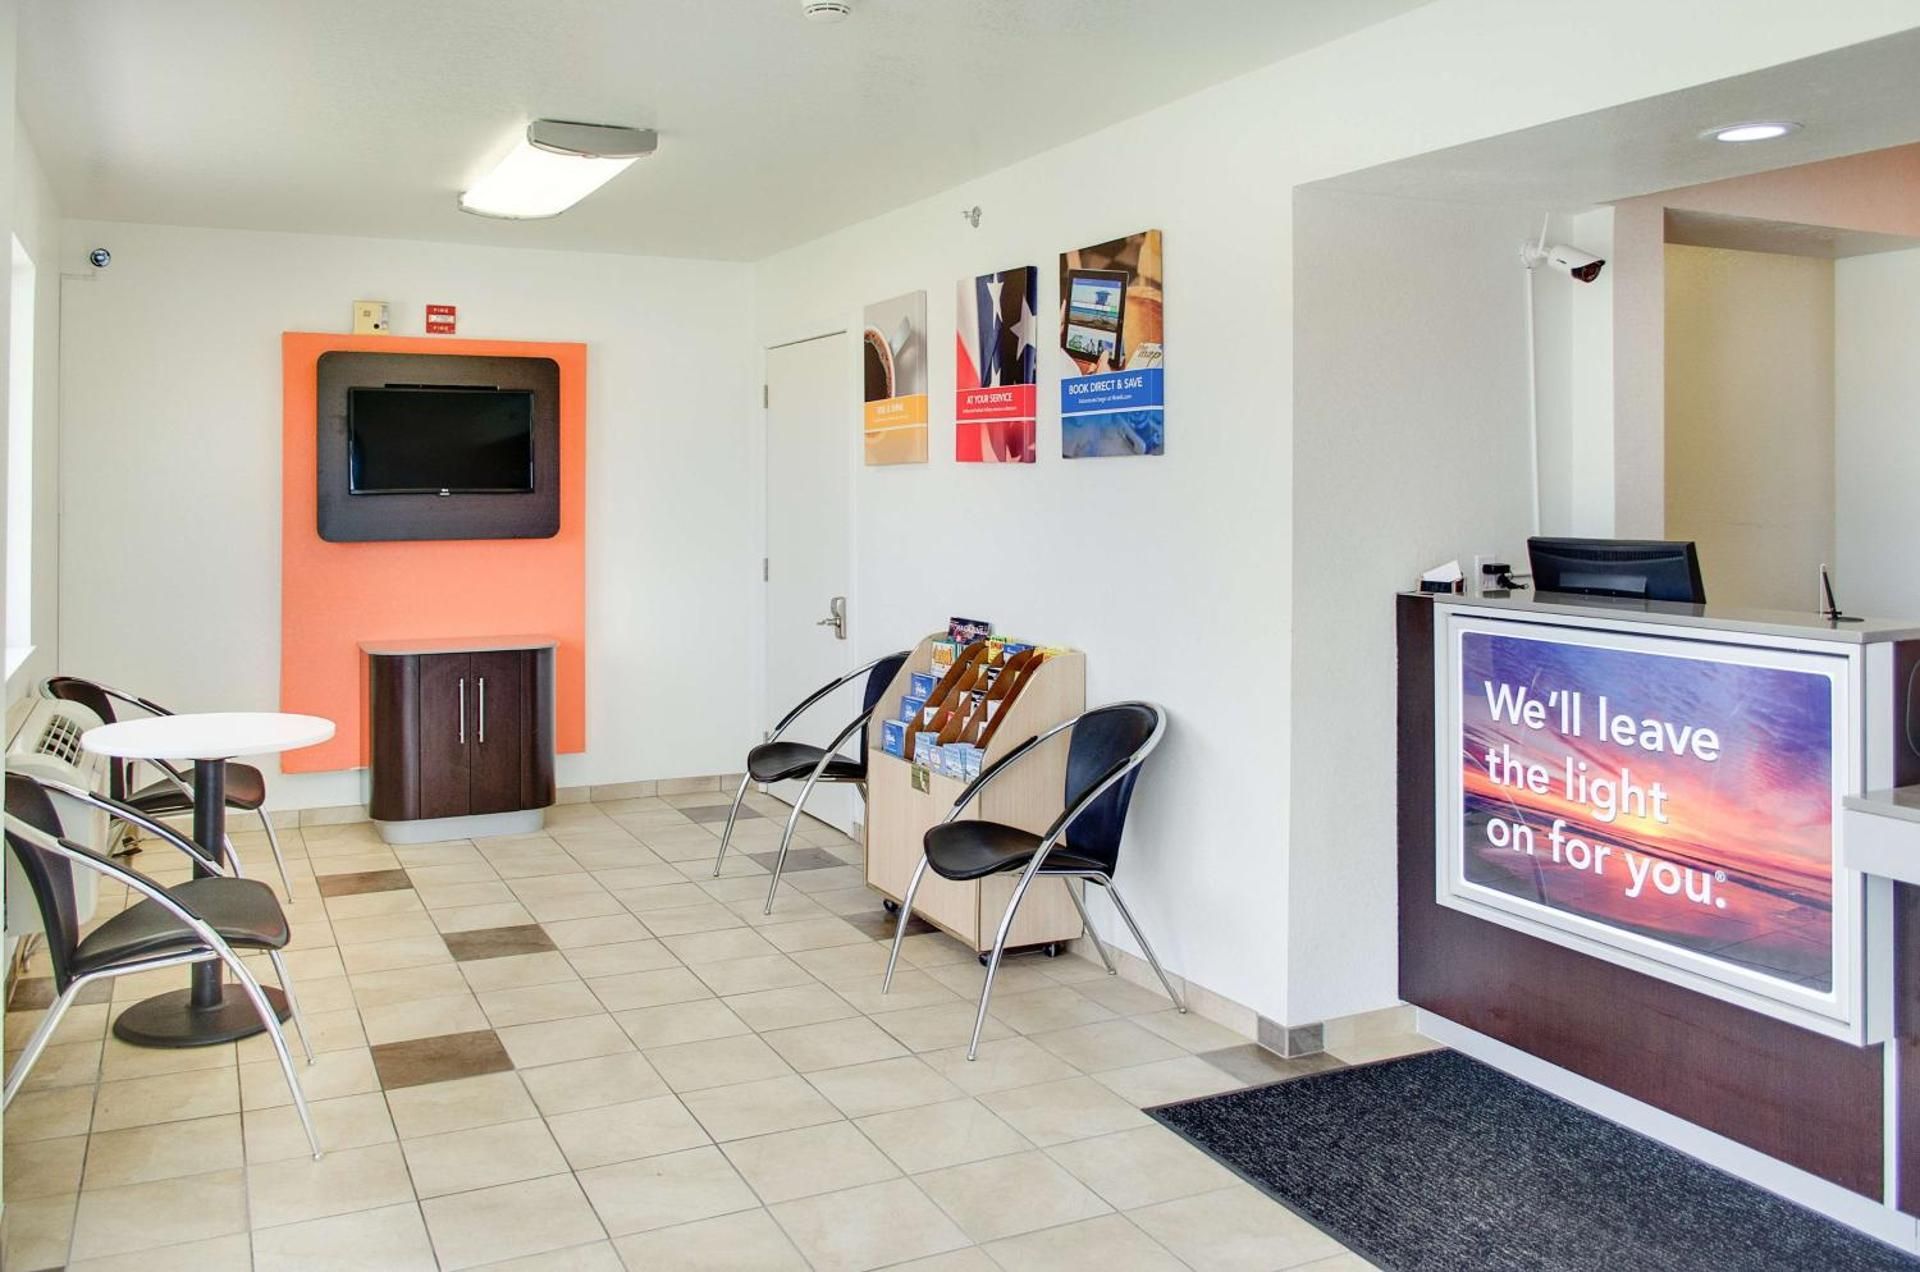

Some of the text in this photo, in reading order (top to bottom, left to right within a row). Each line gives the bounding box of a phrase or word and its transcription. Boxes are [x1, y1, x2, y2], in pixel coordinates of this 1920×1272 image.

[966, 392, 1013, 404] AT YOUR SERVICE
[1068, 376, 1143, 395] BOOK DIRECT & SAVE
[1484, 680, 1720, 761] We'll leave
[1485, 743, 1668, 823] the light
[1486, 817, 1534, 855] on
[1548, 819, 1611, 875] for
